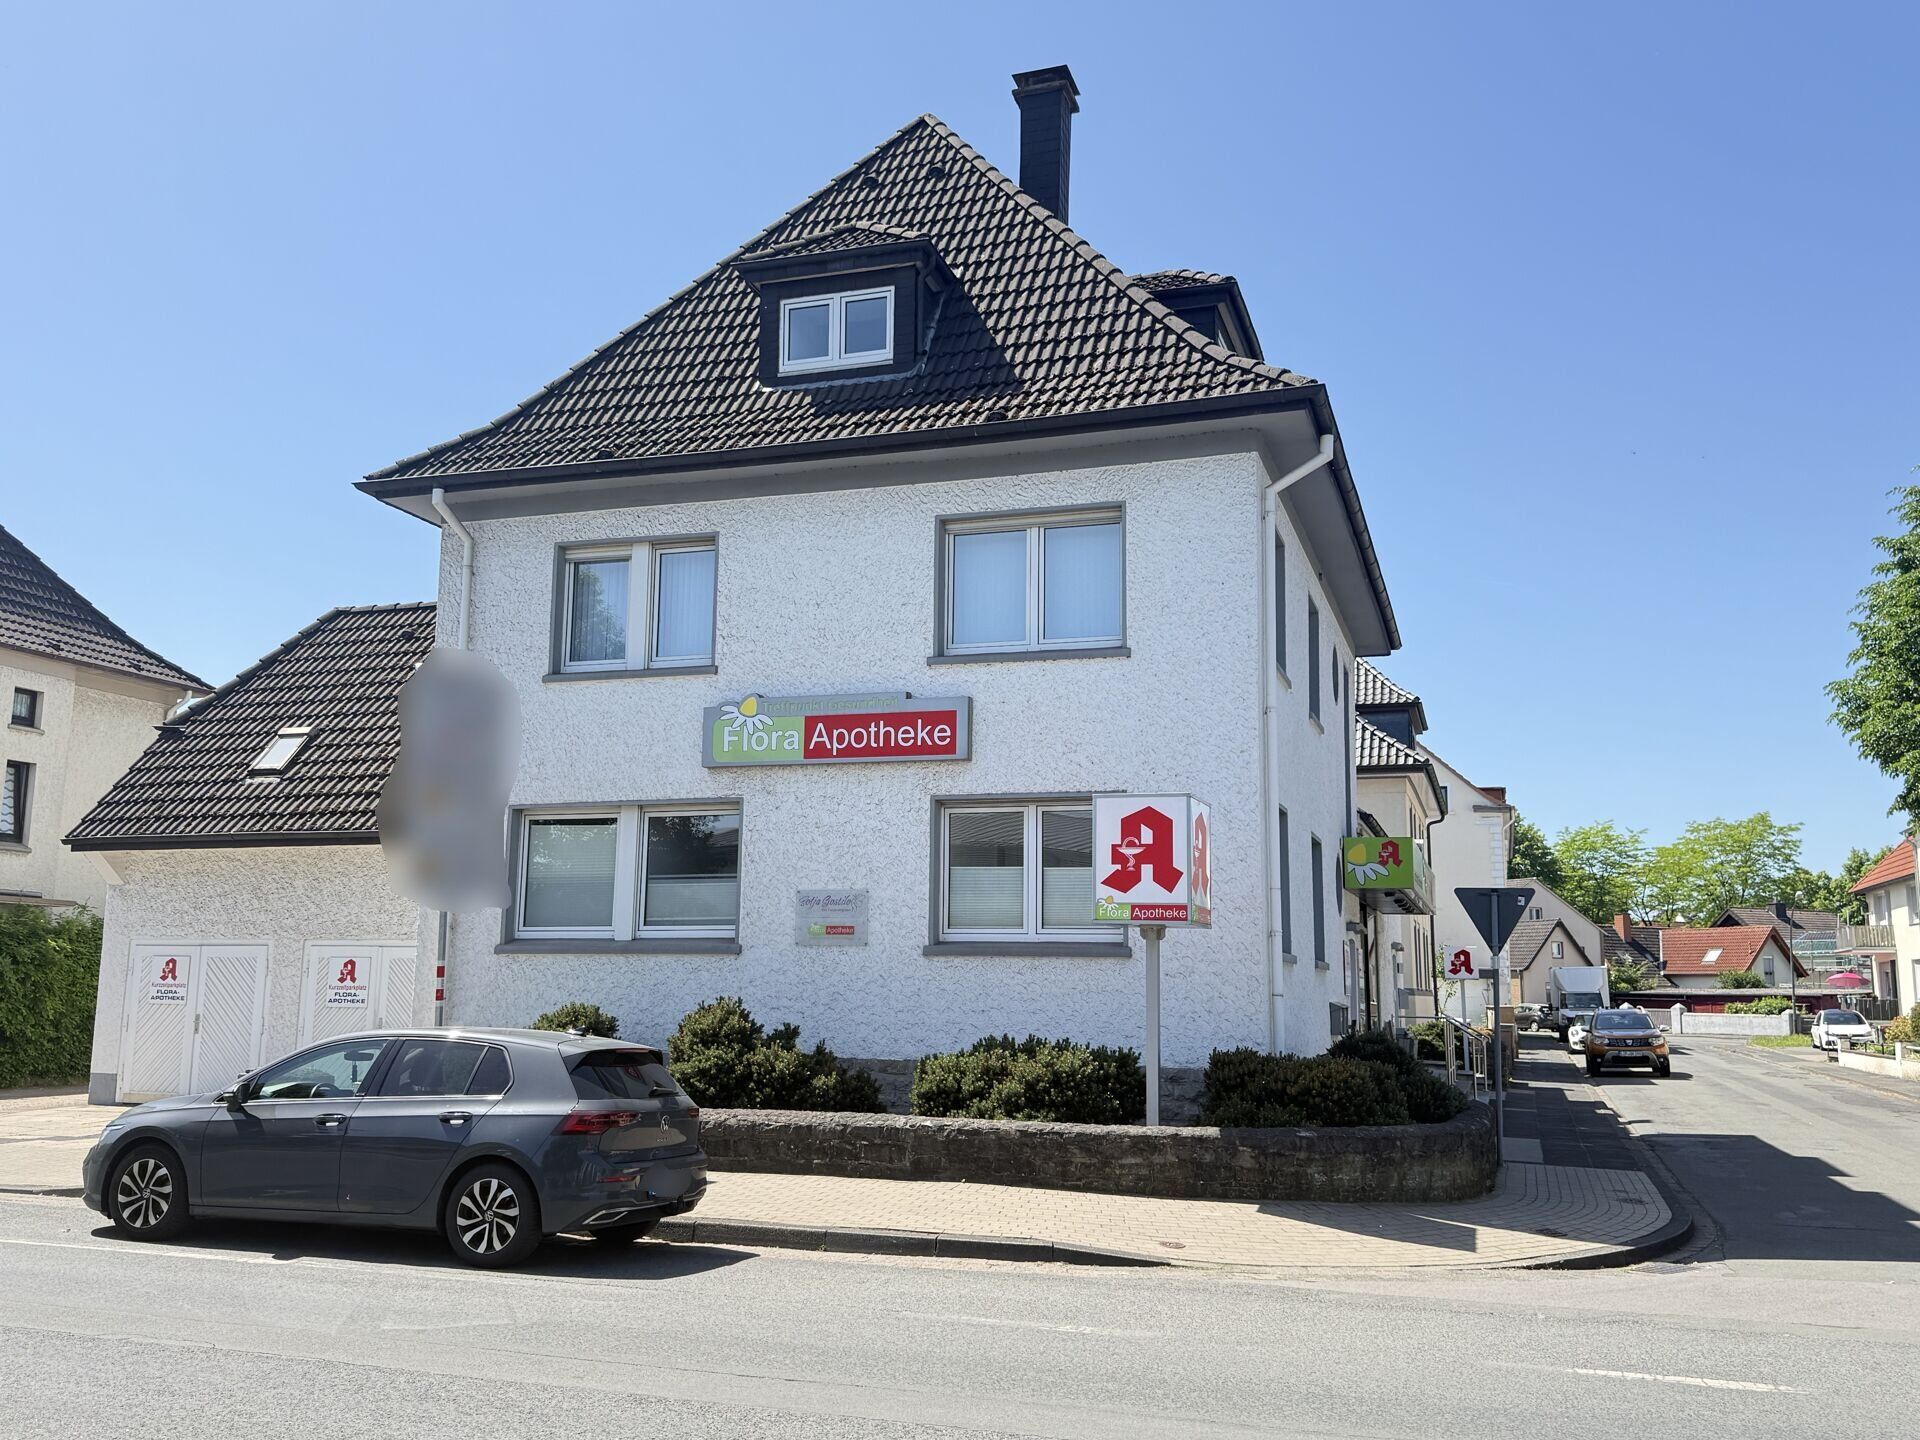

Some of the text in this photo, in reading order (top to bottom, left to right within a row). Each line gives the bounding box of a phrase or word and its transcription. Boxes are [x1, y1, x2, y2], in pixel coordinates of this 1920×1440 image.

[723, 718, 952, 755] Flora Apotheke
[1099, 907, 1130, 918] Flora
[1132, 906, 1187, 920] Apotheke
